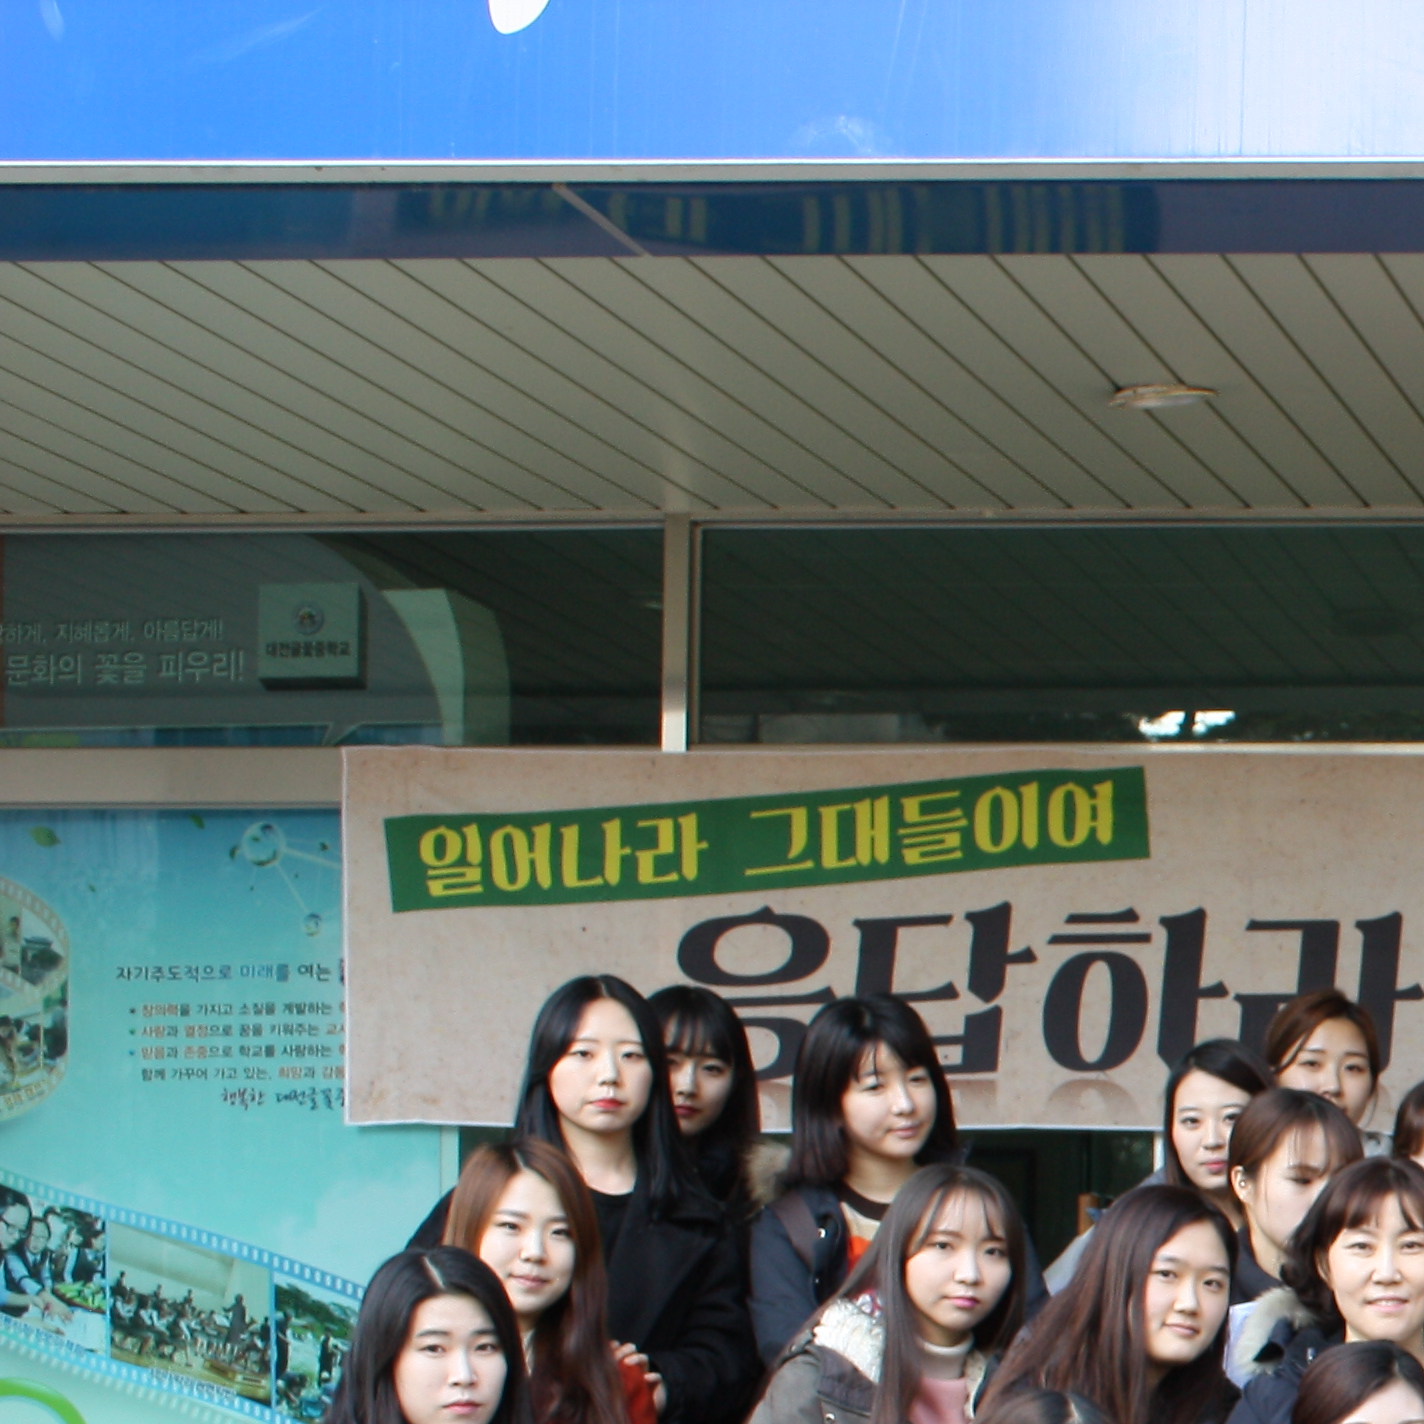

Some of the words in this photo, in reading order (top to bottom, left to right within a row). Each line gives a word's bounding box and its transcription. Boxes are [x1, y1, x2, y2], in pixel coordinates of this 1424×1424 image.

[0, 620, 47, 645] 하게,
[6, 652, 82, 686] 문화의
[95, 651, 147, 684] 꽃을
[159, 649, 243, 683] 피우리!
[418, 812, 709, 897] 일어나라
[744, 780, 1116, 876] 그대들이여
[116, 964, 233, 982] 자기주도적으로
[240, 964, 289, 982] 미래를
[297, 963, 332, 982] 여는
[676, 899, 1424, 1085] 응답하라
[197, 1003, 233, 1017] 가지고
[141, 1024, 178, 1039] 사랑과
[239, 1044, 275, 1058] 학교를
[214, 1067, 238, 1080] 가고
[221, 1087, 265, 1112] 행복한
